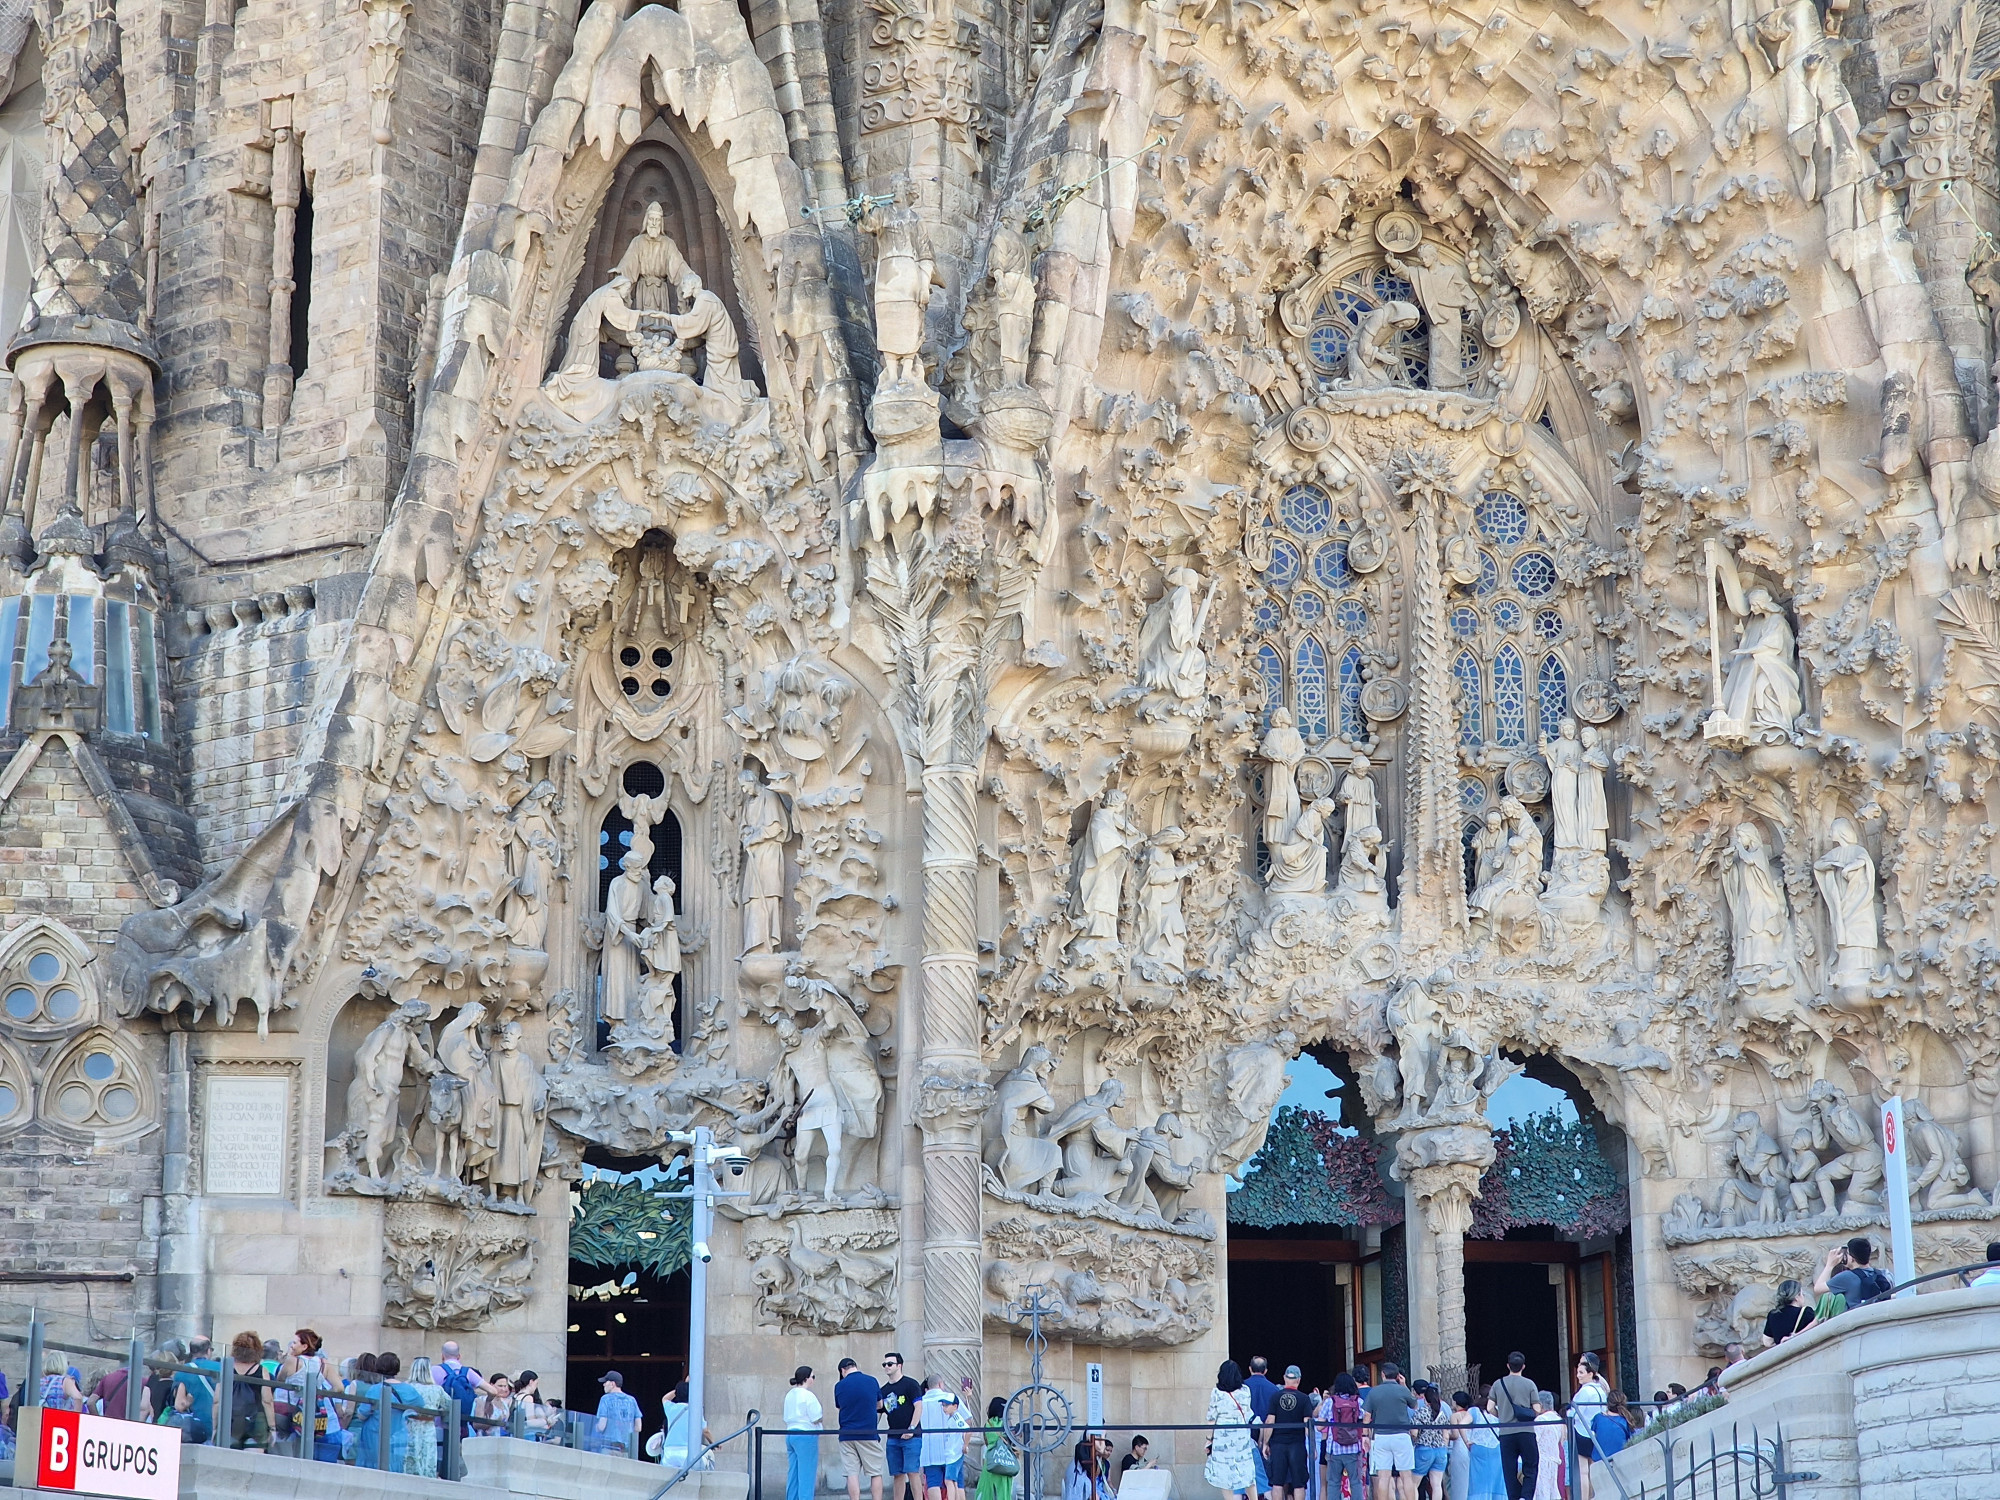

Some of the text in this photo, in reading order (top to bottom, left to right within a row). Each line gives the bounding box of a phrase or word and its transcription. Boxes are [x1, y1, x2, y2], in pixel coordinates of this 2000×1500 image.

[227, 1112, 255, 1121] JOAN
[50, 1427, 158, 1476] B GRUPOS
